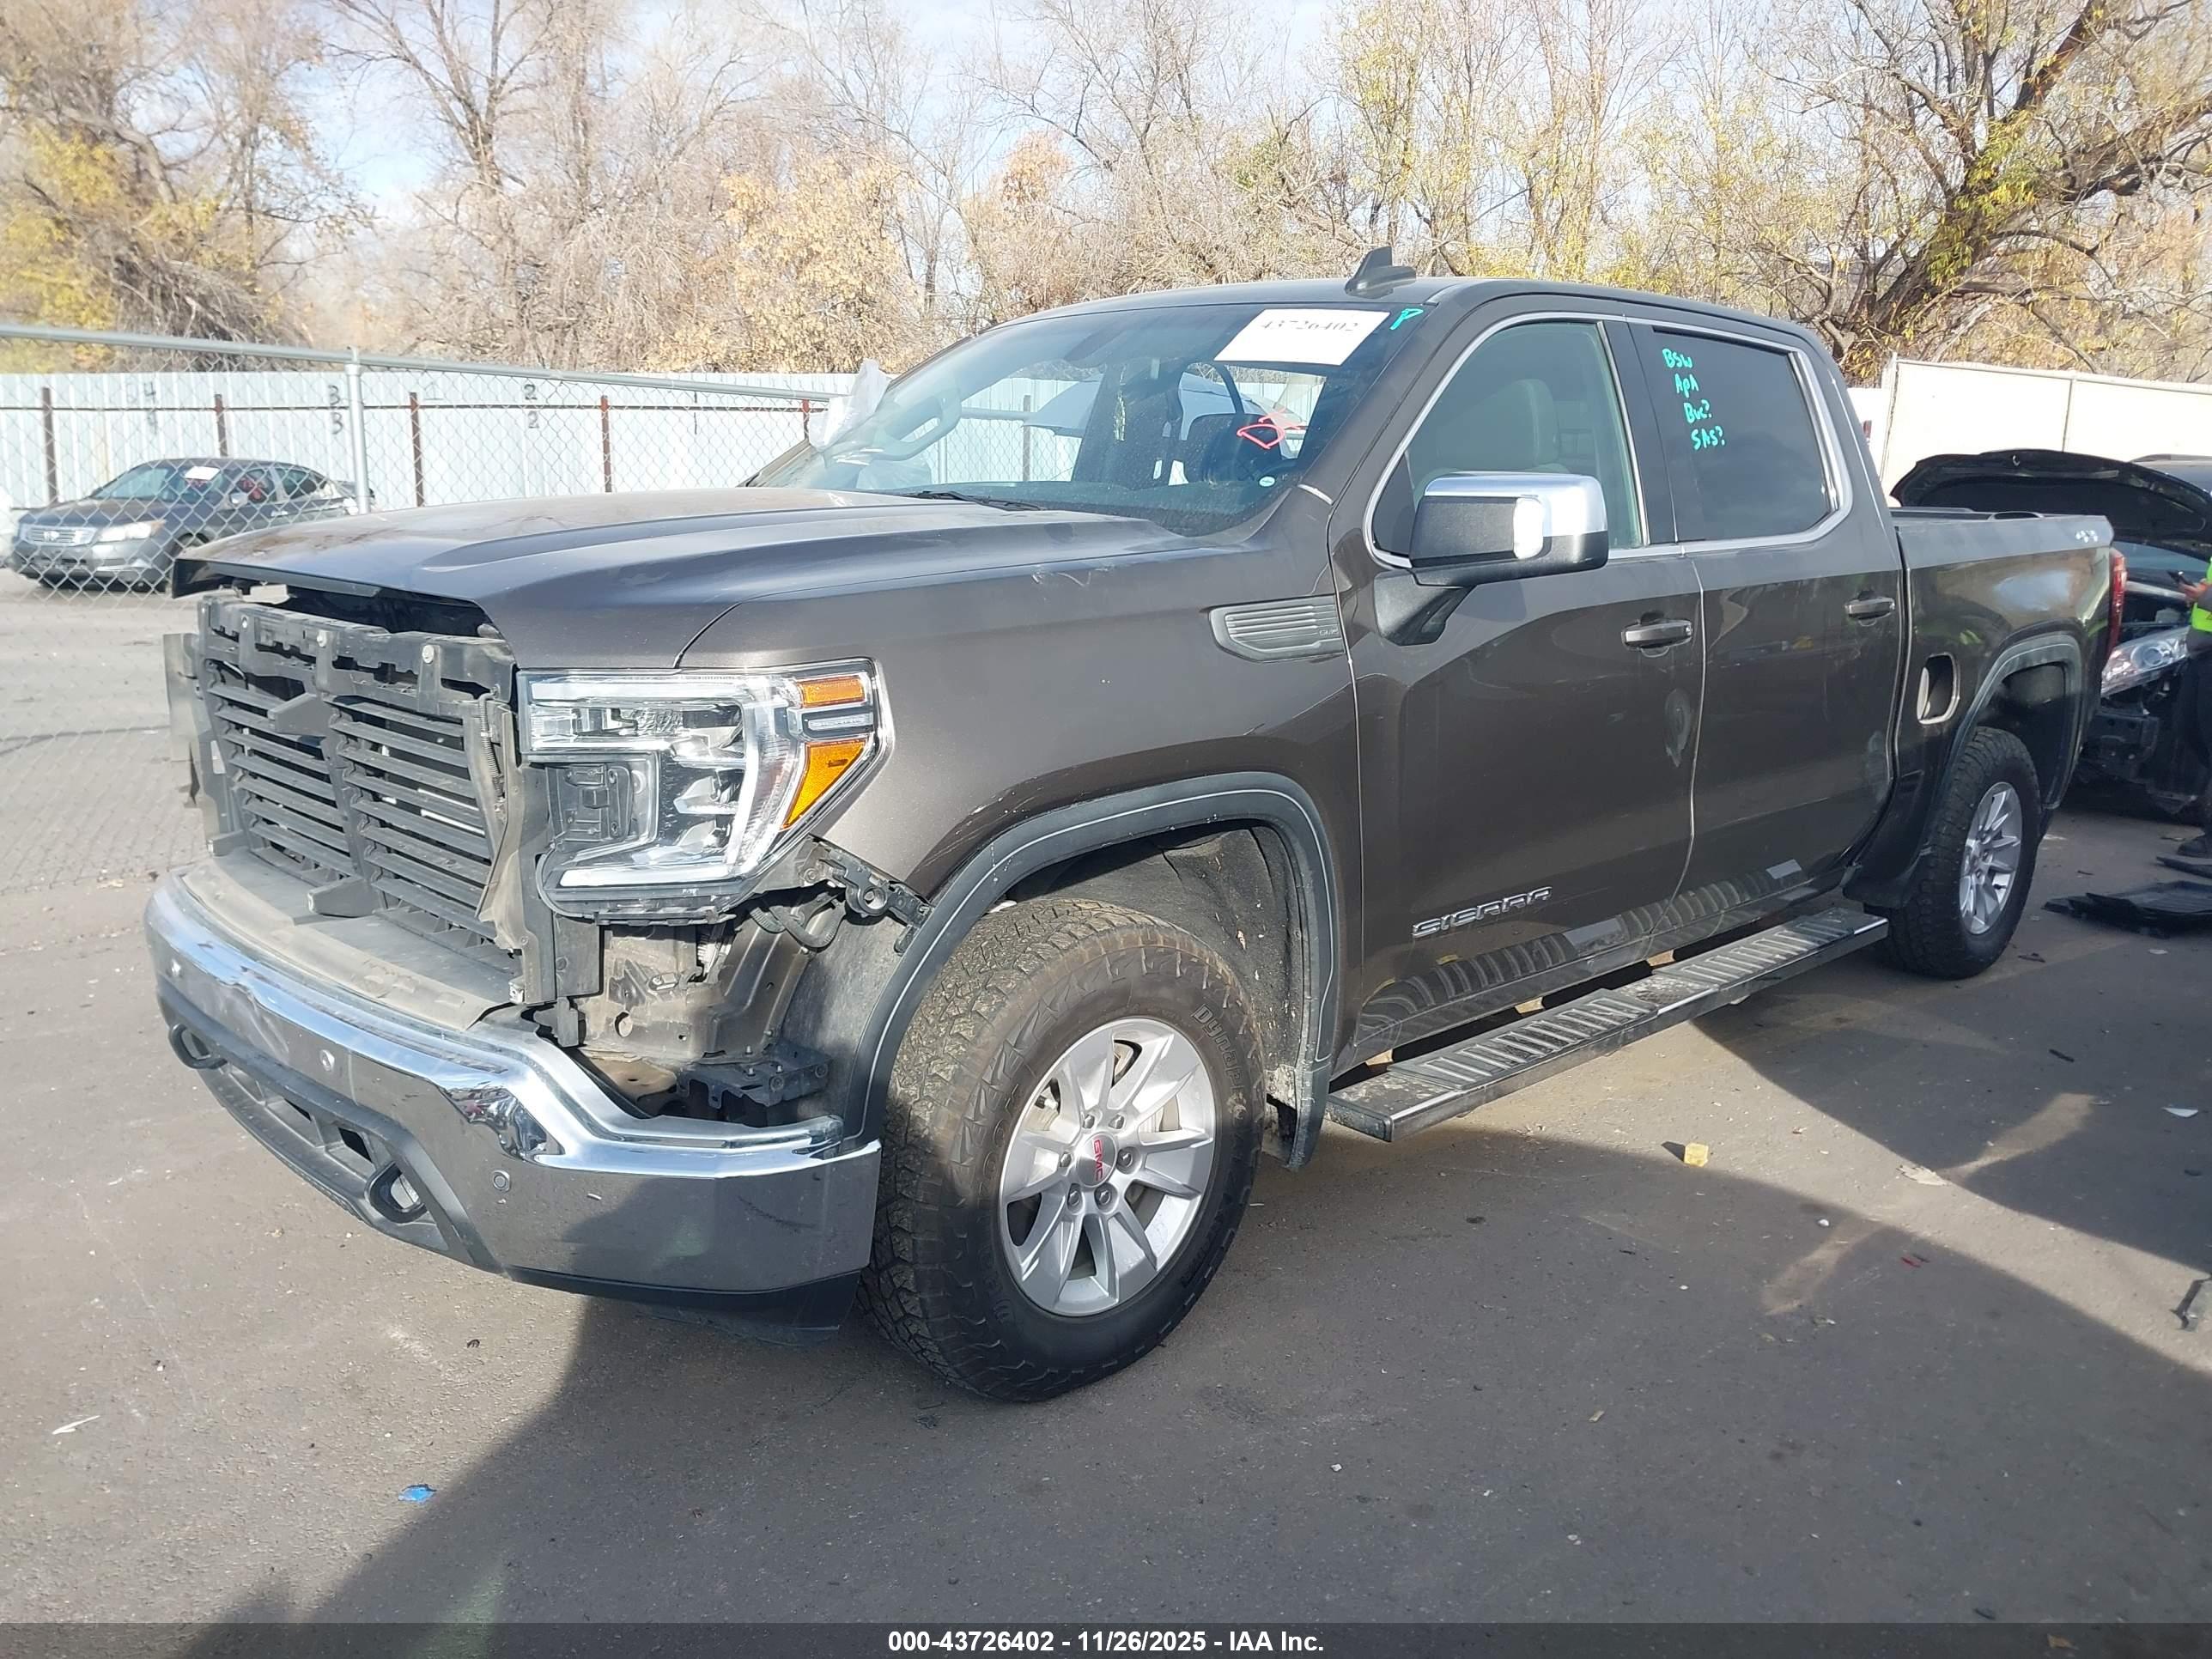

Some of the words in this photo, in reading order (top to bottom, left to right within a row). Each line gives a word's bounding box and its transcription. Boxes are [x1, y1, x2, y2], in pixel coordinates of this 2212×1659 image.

[329, 385, 341, 405] 3
[524, 383, 538, 400] 2
[331, 411, 343, 434] 3
[528, 410, 540, 428] 2
[1411, 886, 1553, 939] SIERRA
[1093, 1139, 1103, 1182] GMC
